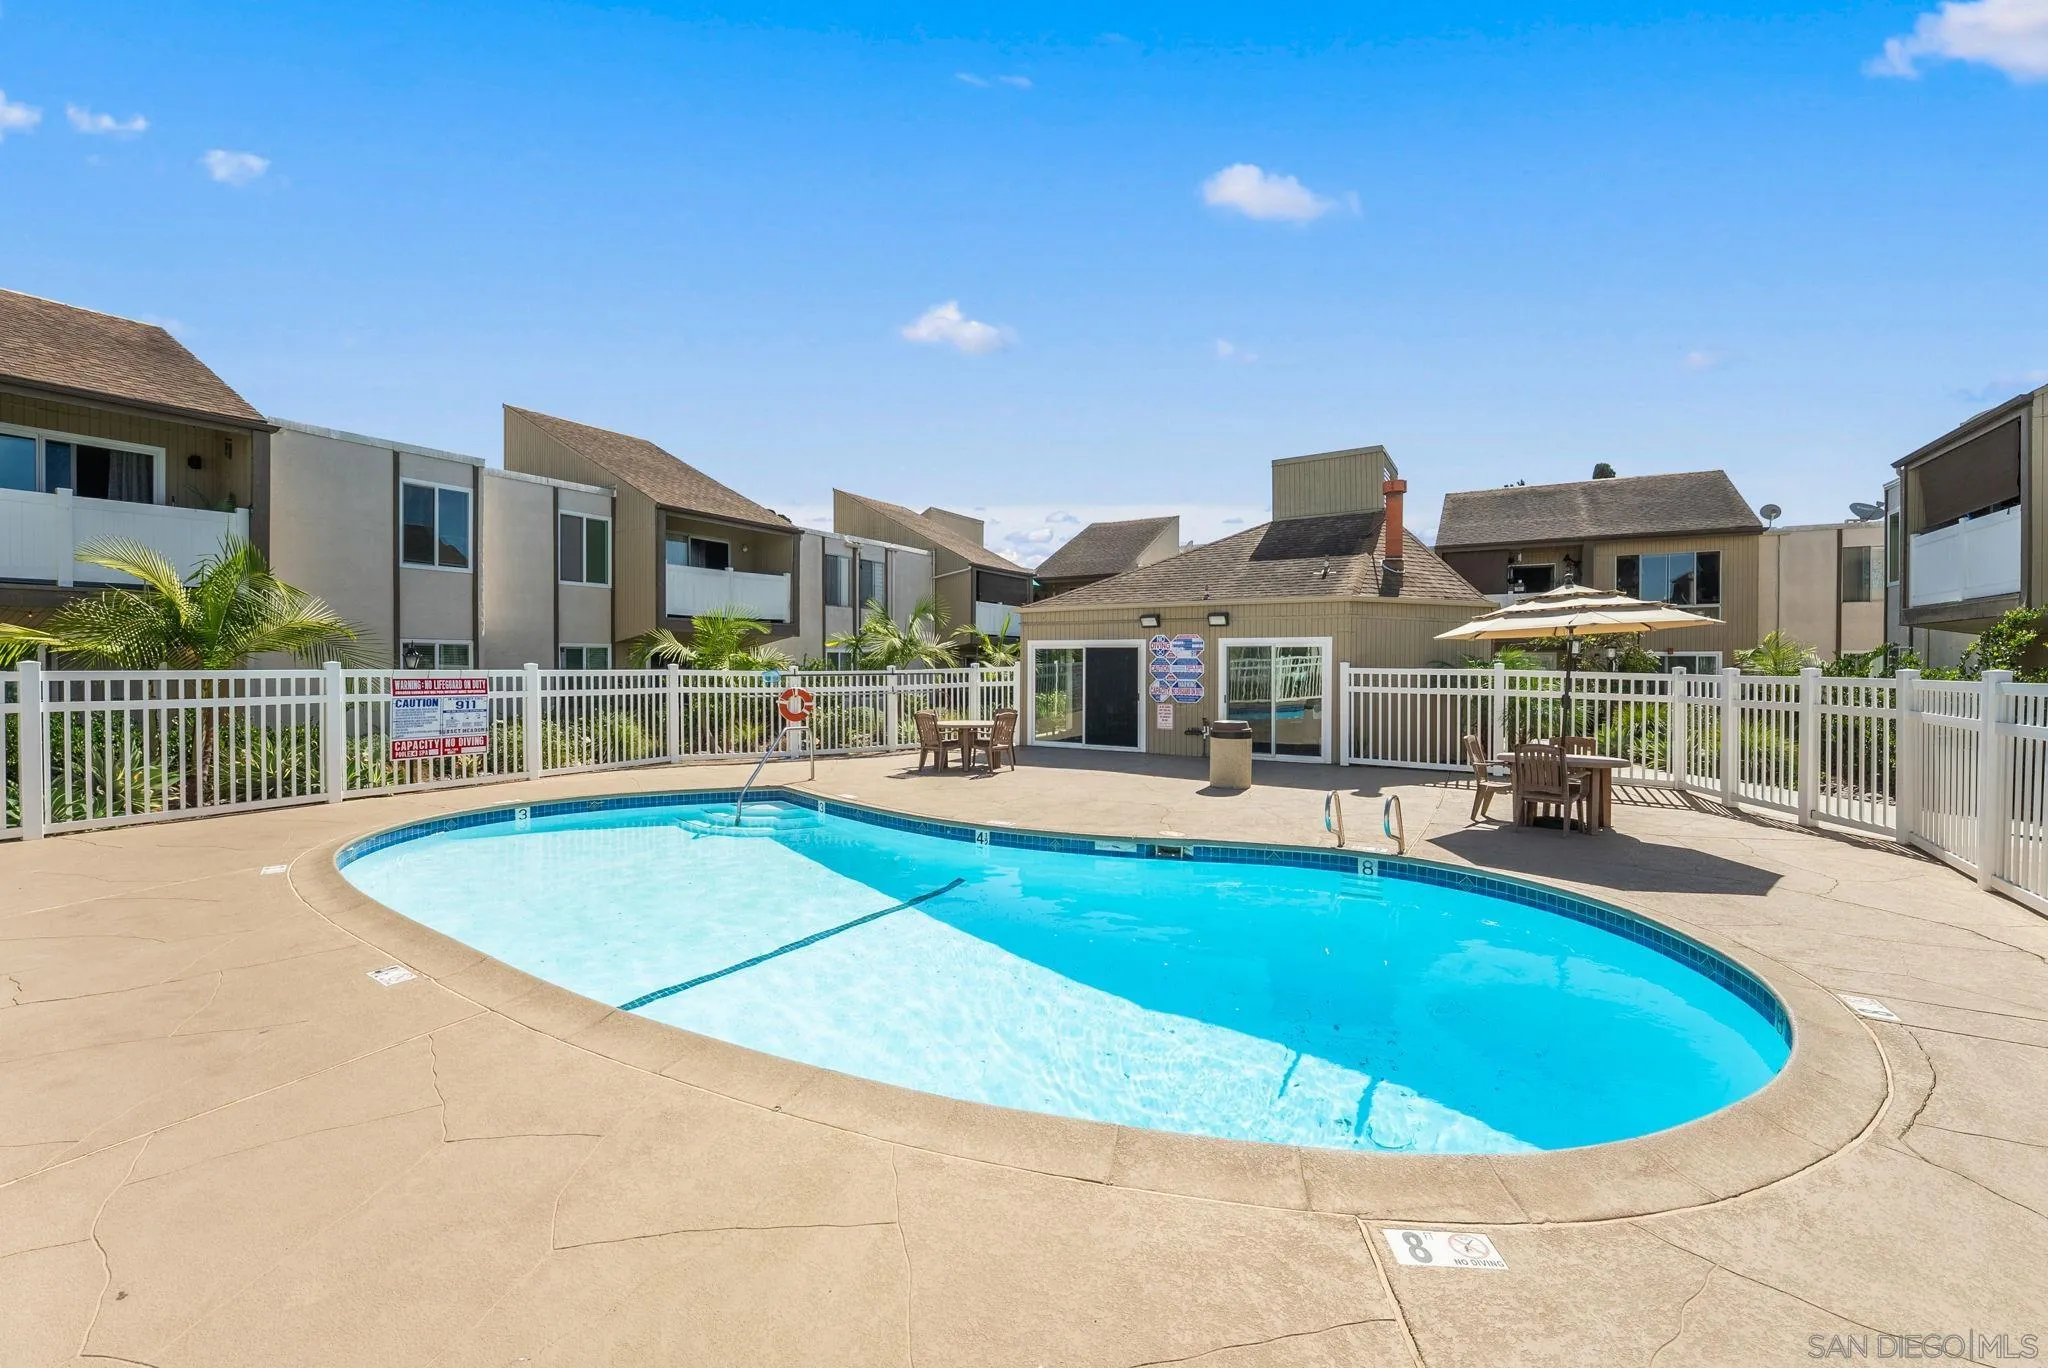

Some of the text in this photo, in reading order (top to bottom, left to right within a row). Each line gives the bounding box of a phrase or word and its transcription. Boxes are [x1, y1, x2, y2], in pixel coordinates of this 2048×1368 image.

[1151, 642, 1170, 650] DIVING
[425, 680, 433, 690] NO
[434, 680, 462, 690] LIFEGUARD
[463, 680, 471, 690] ON
[472, 680, 486, 690] DUTY
[395, 698, 439, 708] CAUTION
[455, 700, 476, 709] 911
[394, 739, 440, 752] CAPACITY
[445, 736, 484, 748] NO DIVING
[518, 808, 528, 821] 3
[1362, 860, 1374, 876] 8
[1401, 1231, 1433, 1264] 8
[1454, 1258, 1505, 1268] NO DIVING
